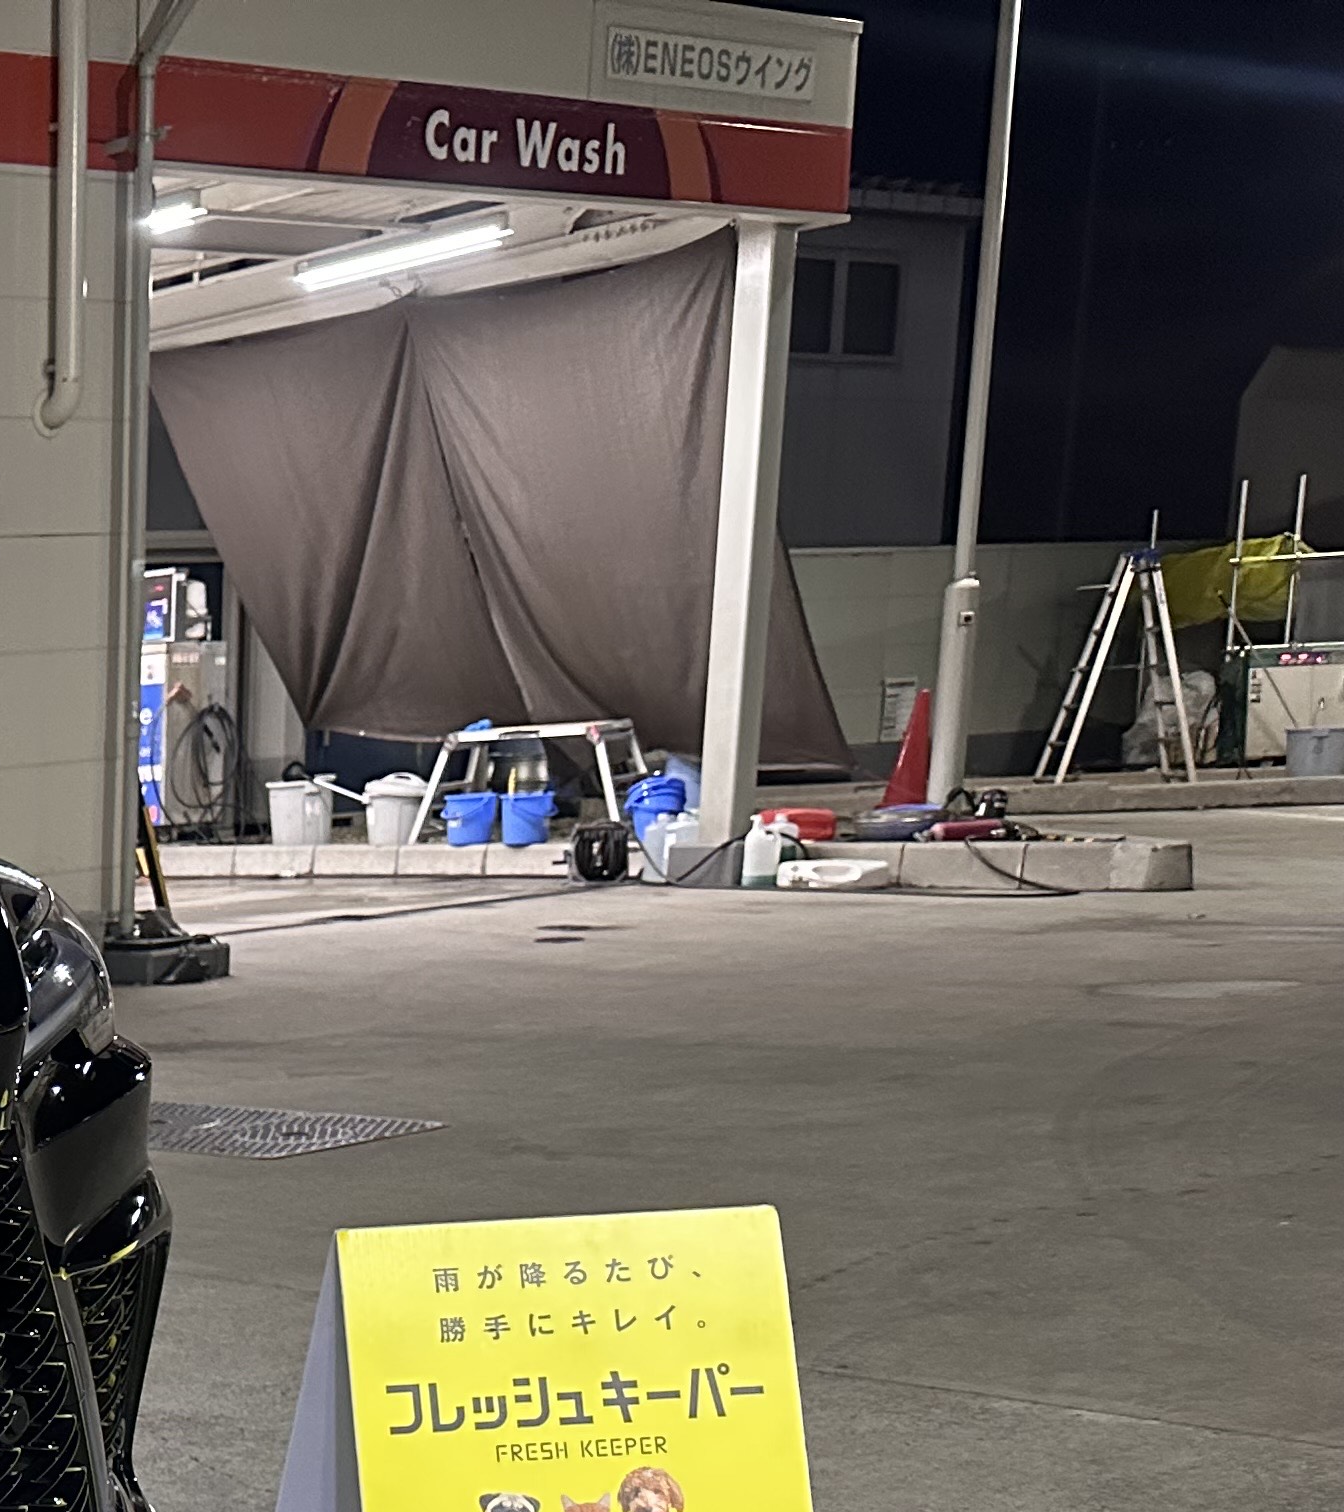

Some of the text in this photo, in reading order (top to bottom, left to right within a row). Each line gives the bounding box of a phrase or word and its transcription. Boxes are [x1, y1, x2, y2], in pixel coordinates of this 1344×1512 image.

[424, 108, 627, 176] Car Wash
[432, 1254, 702, 1294] 雨が降るたび、
[439, 1304, 707, 1344] 勝手にキレイ。
[385, 1362, 765, 1436] フレッシュキーパー
[495, 1436, 668, 1463] FRESH KEEPER
